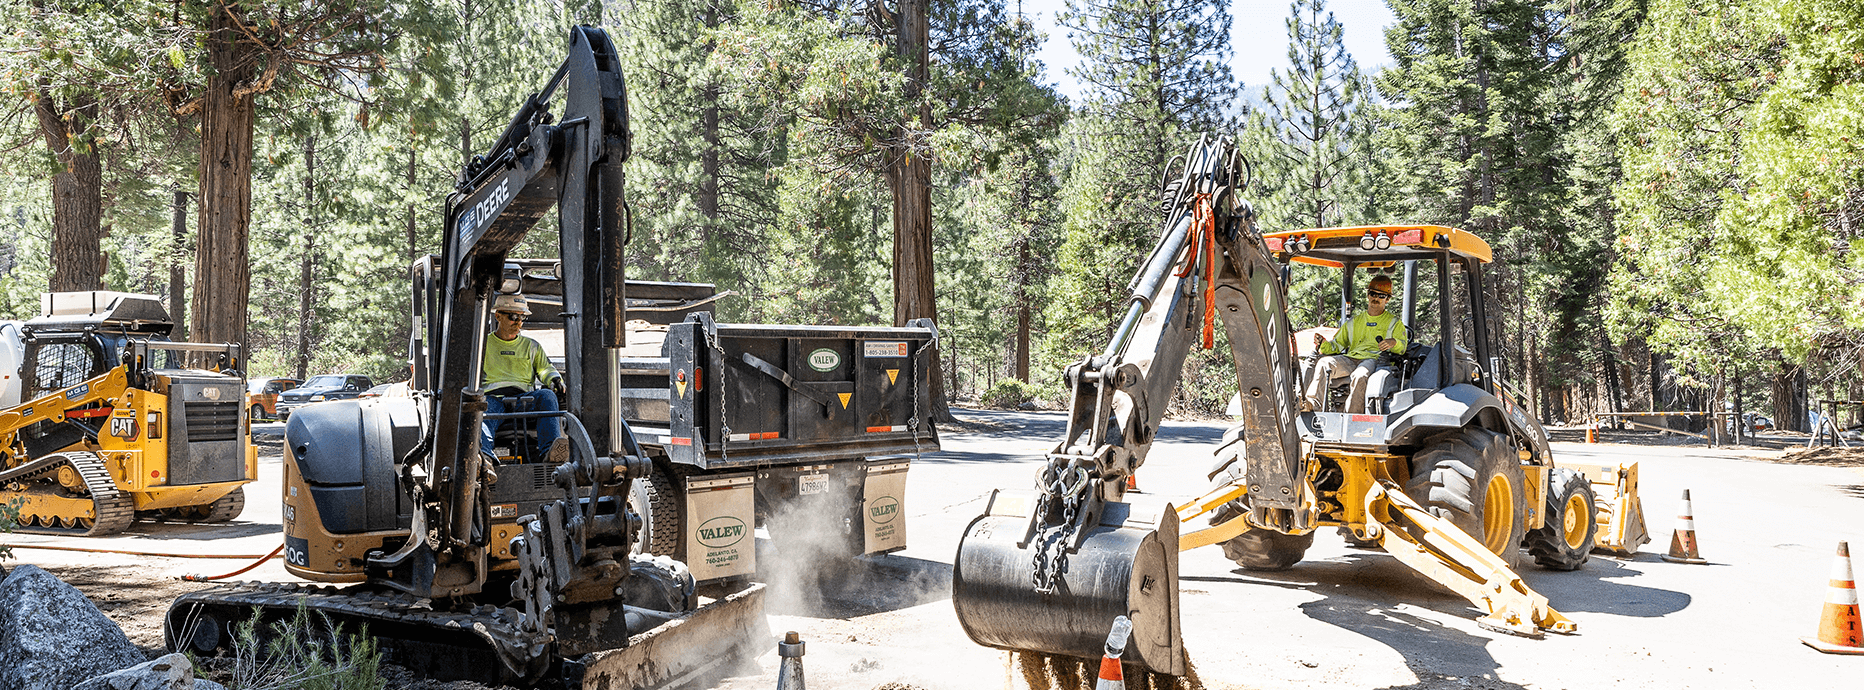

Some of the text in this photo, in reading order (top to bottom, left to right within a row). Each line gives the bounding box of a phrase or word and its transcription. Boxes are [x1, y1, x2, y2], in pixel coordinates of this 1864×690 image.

[476, 177, 509, 228] DEERE
[814, 355, 834, 364] VALEW
[1267, 313, 1290, 433] DEERE
[204, 387, 216, 397] CAT
[111, 419, 134, 436] CAT
[1525, 424, 1540, 445] 410L
[870, 504, 897, 517] VALEW
[699, 525, 743, 539] VALEW
